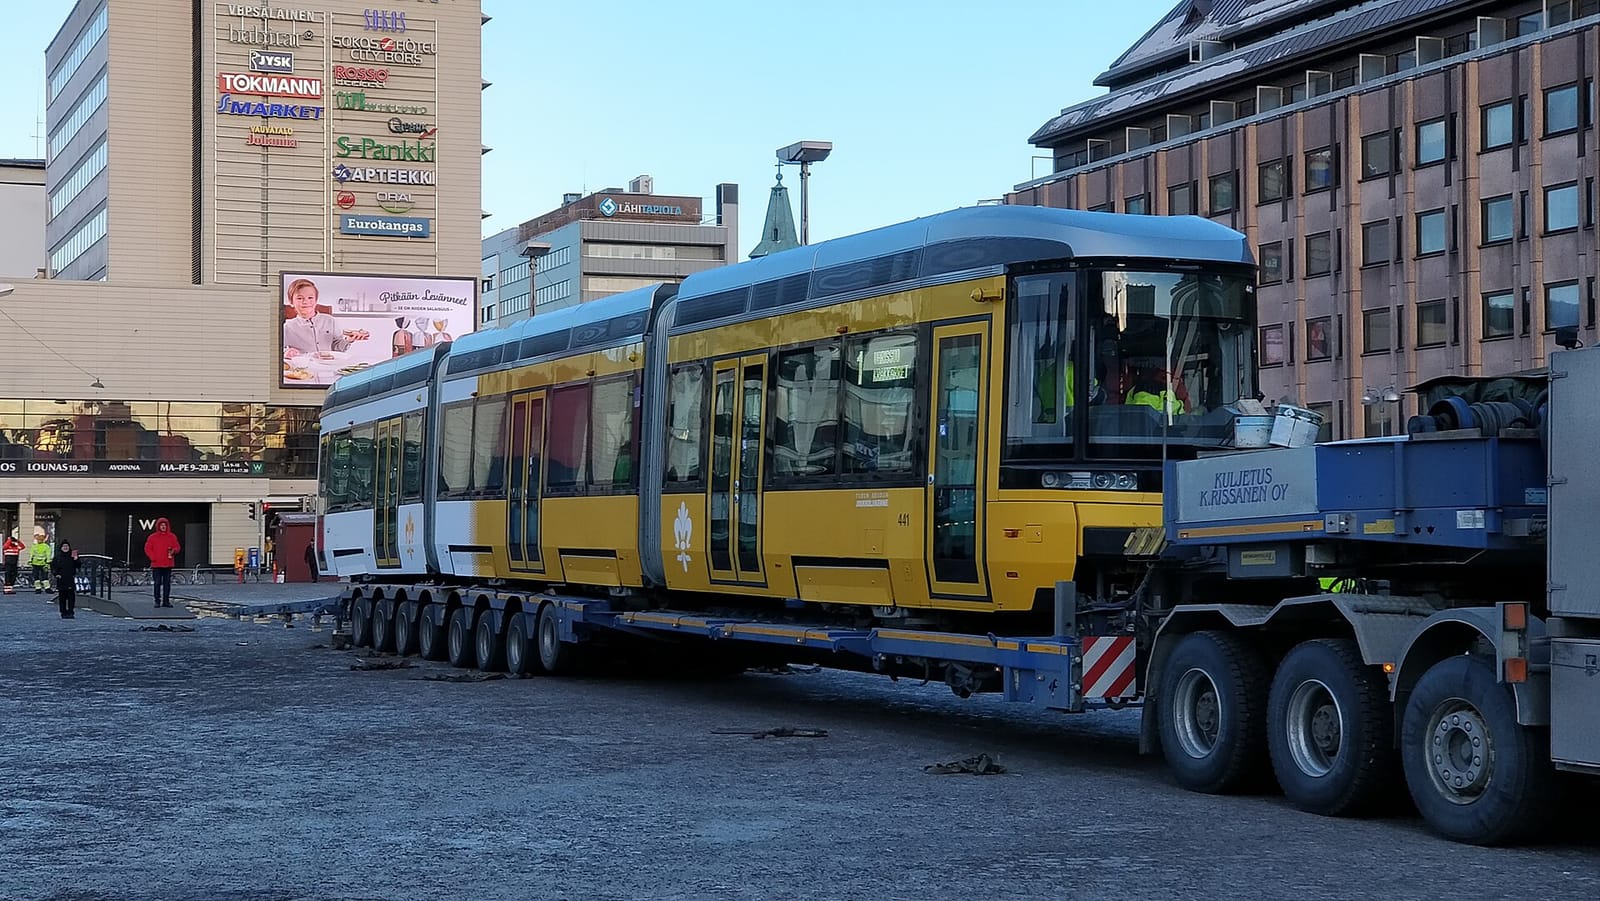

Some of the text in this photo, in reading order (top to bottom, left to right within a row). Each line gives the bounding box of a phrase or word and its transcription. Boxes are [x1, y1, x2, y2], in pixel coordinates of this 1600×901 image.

[364, 9, 406, 33] SOKOS
[332, 35, 380, 50] SOKOS
[258, 55, 291, 67] JYSK
[222, 74, 321, 95] TOKMANNI
[336, 136, 436, 162] S-Pankki
[351, 167, 435, 184] APTEEKKI
[348, 218, 423, 233] Eurokangas
[421, 288, 467, 306] Levänneet
[27, 463, 68, 471] LOUNAS
[1214, 468, 1272, 489] KULJETUS
[1271, 484, 1289, 501] OY
[139, 519, 156, 530] W
[897, 513, 910, 527] 441
